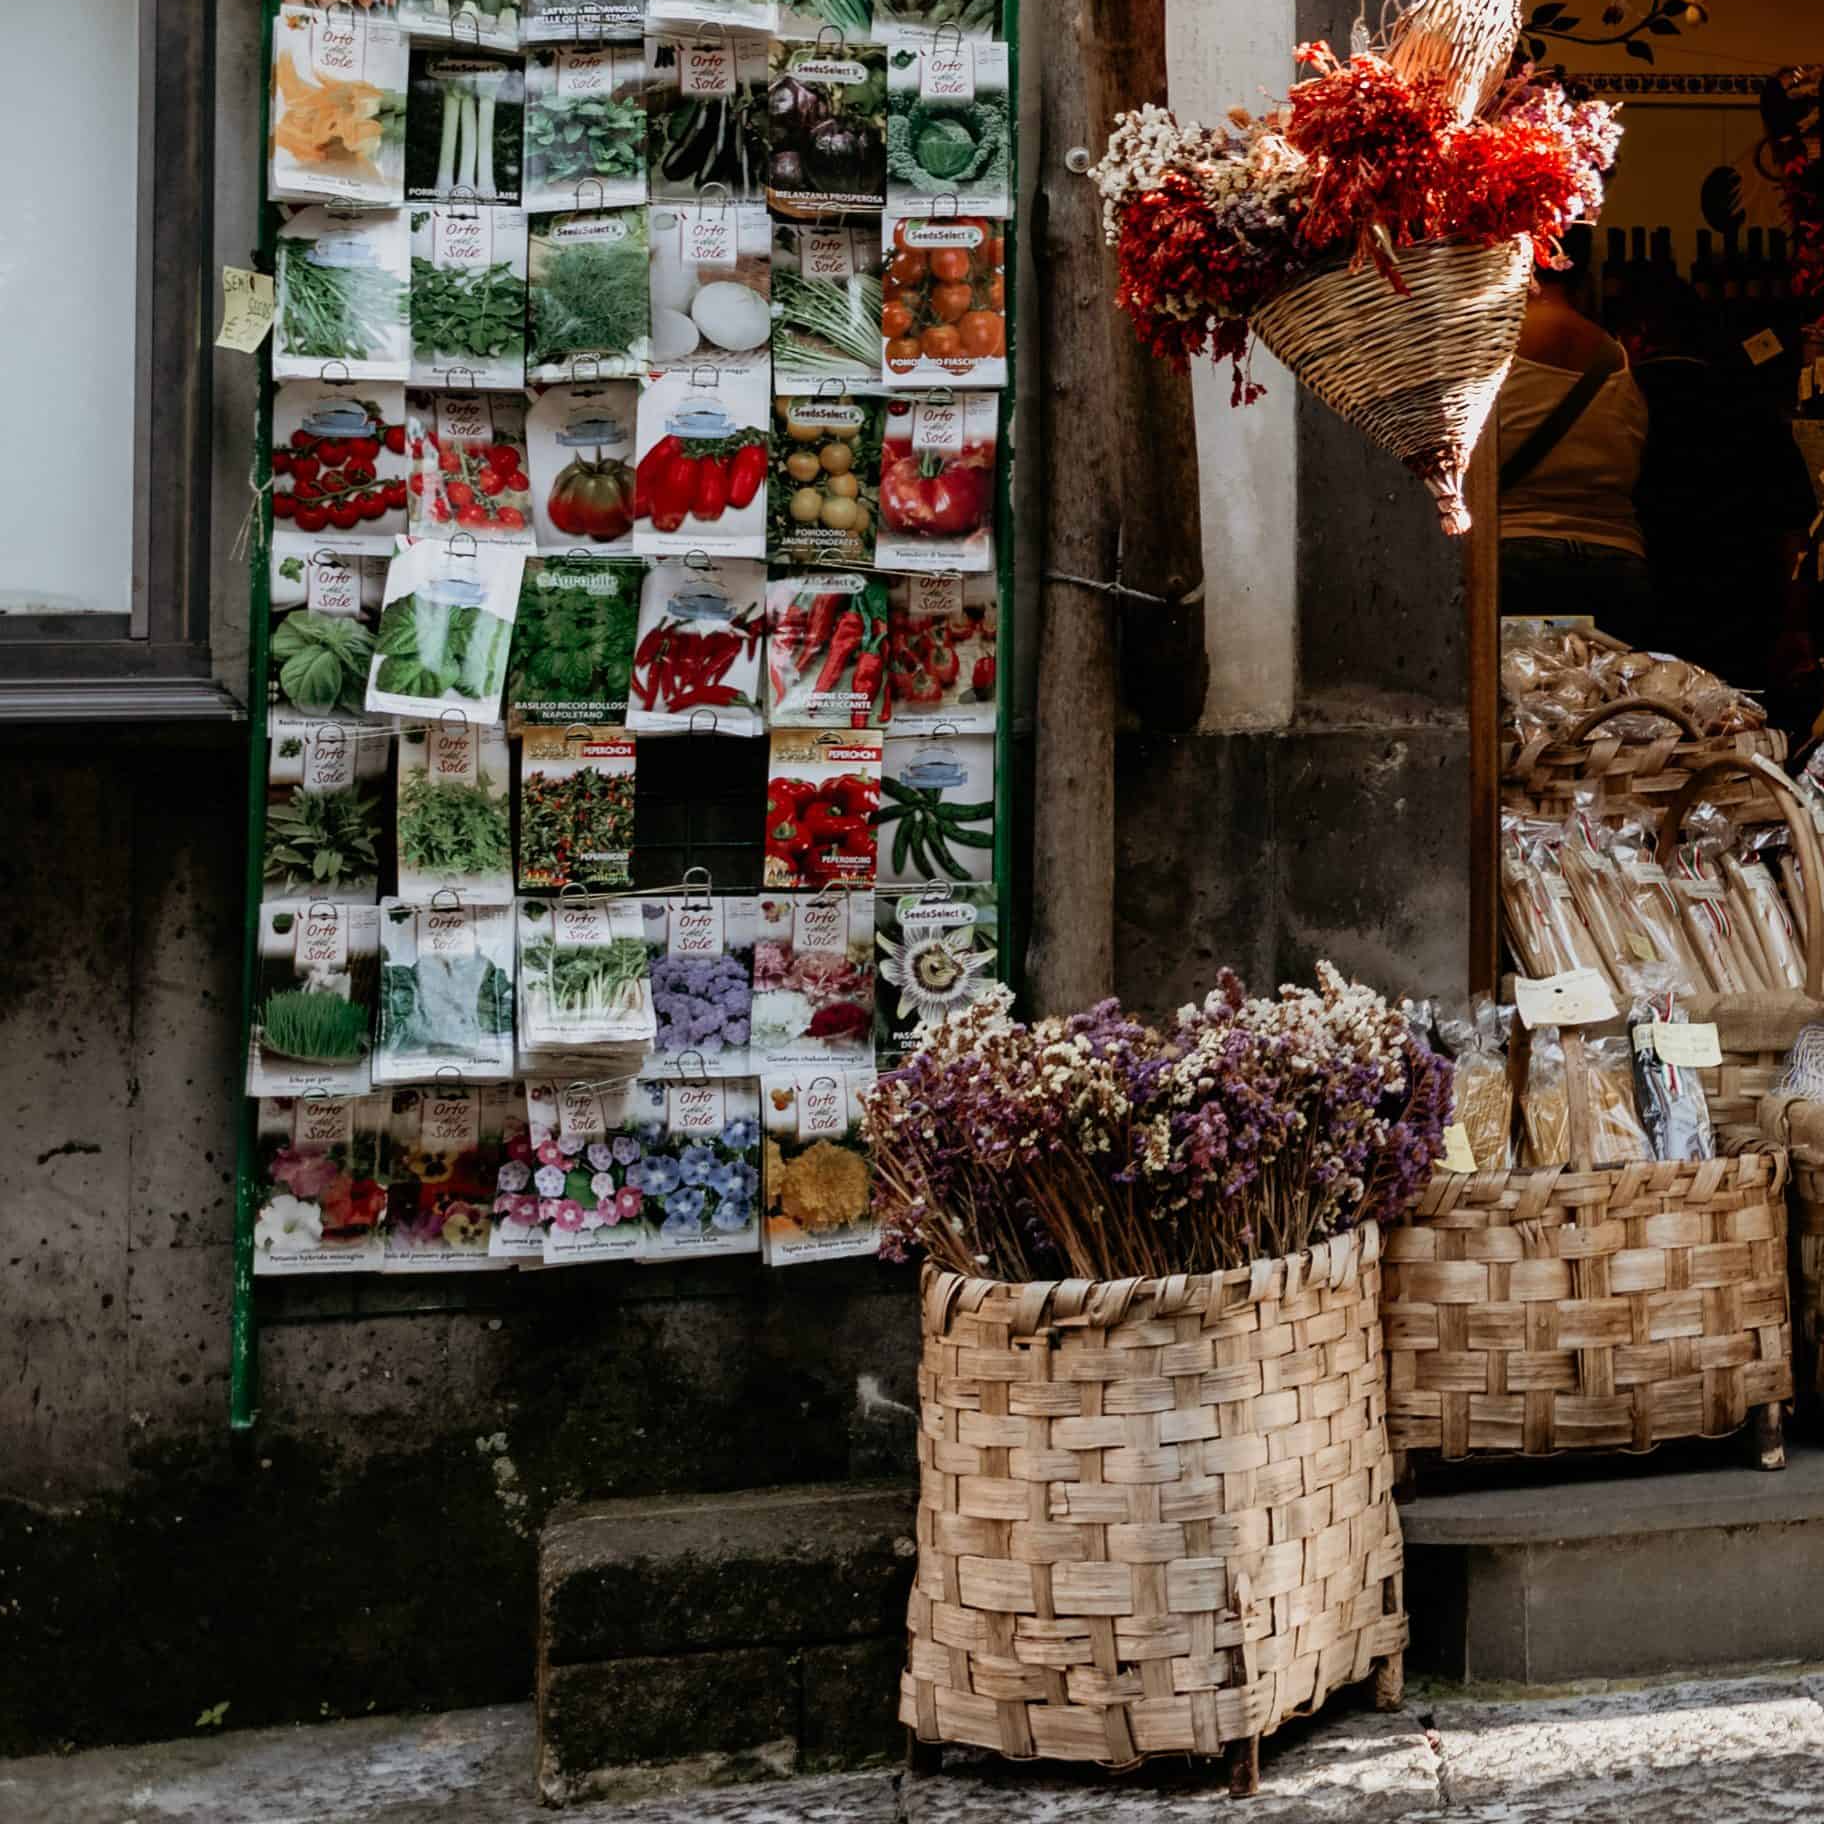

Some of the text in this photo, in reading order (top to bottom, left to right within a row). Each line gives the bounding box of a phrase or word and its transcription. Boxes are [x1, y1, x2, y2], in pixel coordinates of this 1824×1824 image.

[322, 31, 354, 44] Orto
[320, 56, 352, 69] Sole
[691, 56, 724, 69] Orto
[931, 61, 962, 72] Orto
[690, 76, 727, 90] Sole
[930, 80, 963, 94] Sole
[446, 223, 480, 236] Orto
[692, 224, 727, 236] Orto
[911, 231, 966, 241] SeedsSelect
[809, 238, 841, 251] Orto
[444, 245, 481, 258] Sole
[691, 245, 727, 258] Sole
[809, 259, 846, 273] Sole
[446, 402, 481, 415] Orto
[794, 407, 848, 418] SeedsSelect
[923, 410, 953, 422] Orto
[446, 423, 483, 436] Sole
[921, 431, 953, 444] Sole
[319, 571, 352, 584] Orto
[318, 594, 352, 608] Sole
[514, 701, 557, 711] BASILICO
[542, 710, 604, 720] NAPOLETANO
[439, 737, 469, 750] Orto
[315, 748, 345, 760] Orto
[438, 760, 468, 775] Sole
[312, 770, 345, 784] Sole
[563, 913, 596, 924] Orto
[804, 911, 837, 924] Orto
[903, 909, 960, 920] SeedsSelect
[428, 916, 464, 929] Orto
[680, 916, 713, 928] Orto
[306, 924, 337, 937] Orto
[677, 938, 713, 951] Sole
[304, 946, 337, 961] Sole
[565, 1096, 593, 1109] Orto
[680, 1092, 713, 1104] Orto
[807, 1094, 835, 1106] Orto
[307, 1104, 343, 1116] Orto
[433, 1103, 468, 1116] Orto
[567, 1117, 597, 1130] Sole
[680, 1114, 713, 1127] Sole
[807, 1116, 839, 1130] Sole
[306, 1126, 344, 1140] Sole
[432, 1126, 468, 1139] Sole
